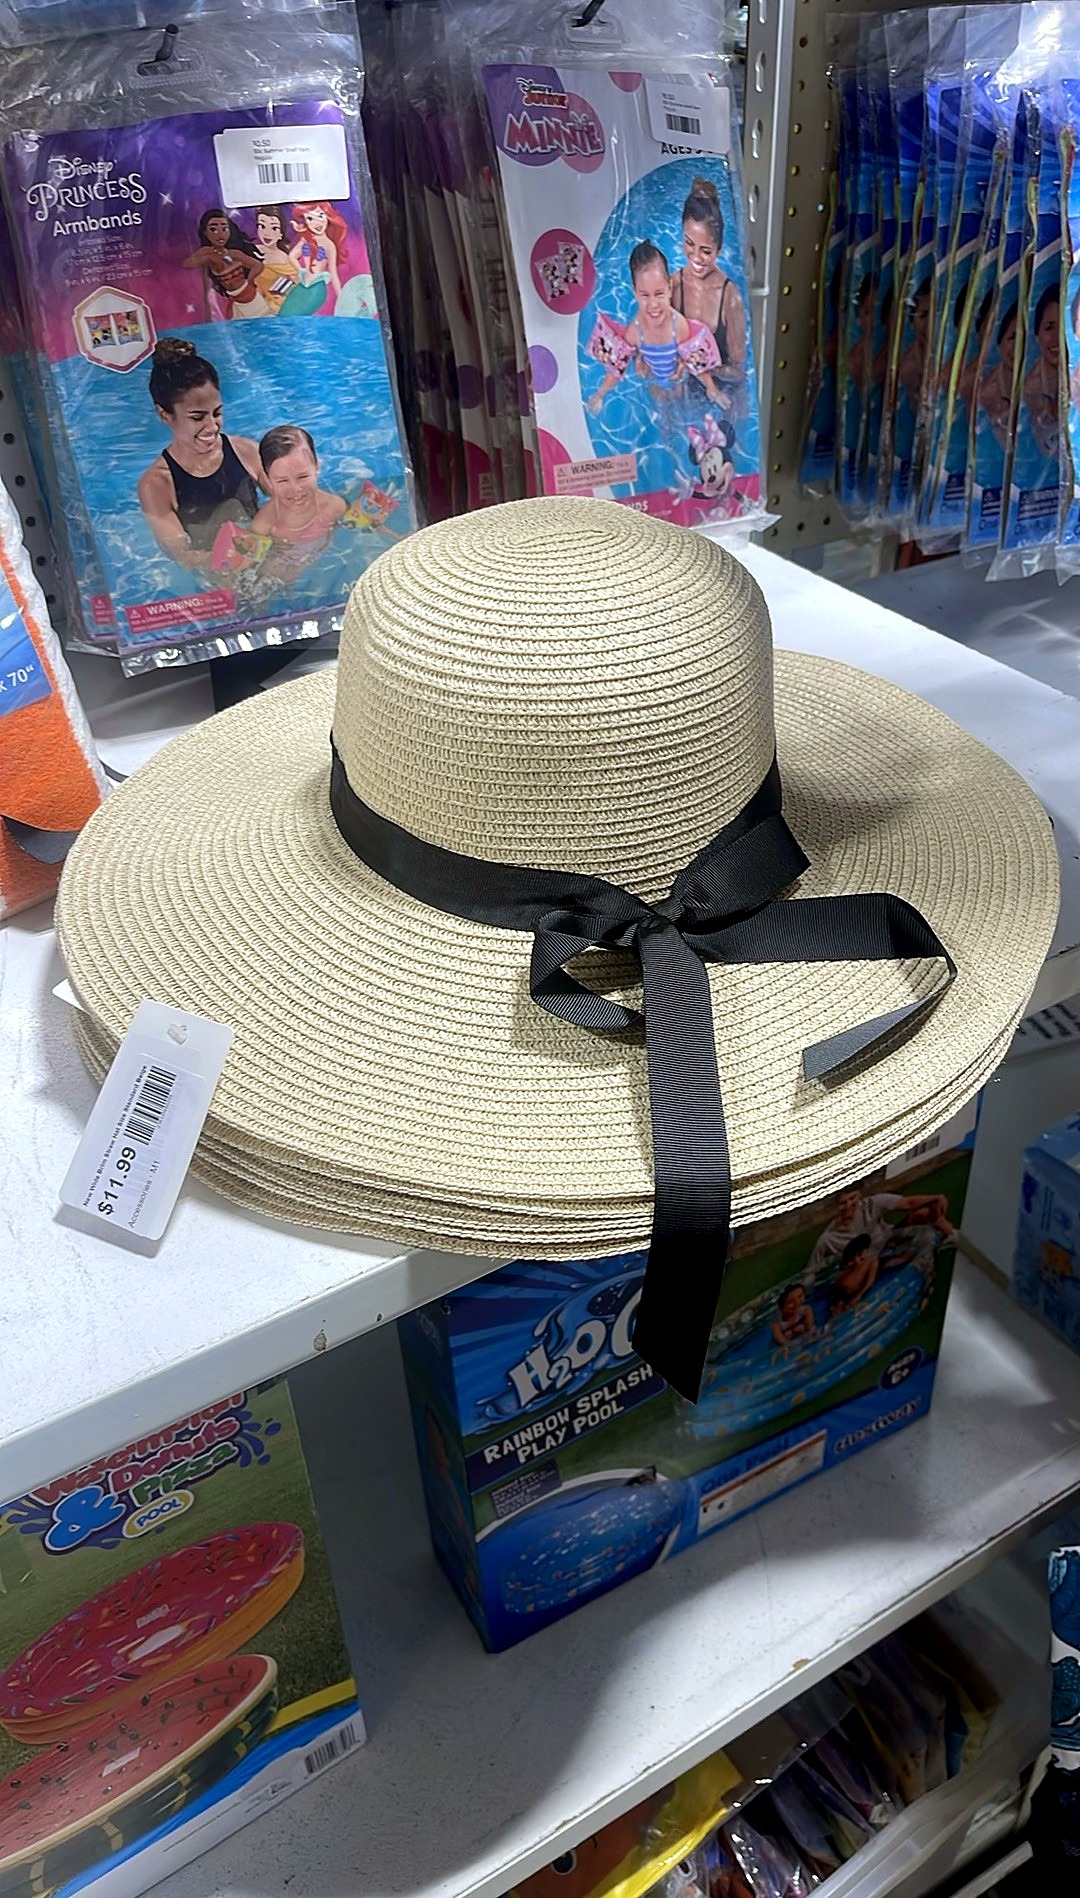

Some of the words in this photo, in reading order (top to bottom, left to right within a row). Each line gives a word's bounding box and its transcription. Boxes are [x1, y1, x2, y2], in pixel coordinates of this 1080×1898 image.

[26, 173, 147, 221] PRINCESS
[53, 210, 142, 237] Armbands
[569, 460, 613, 475] WARNING:
[146, 597, 205, 616] WARNING:
[97, 1146, 136, 1216] $11.99
[127, 1180, 153, 1228] Accessories
[483, 1409, 571, 1465] RAINBOW
[576, 1364, 654, 1416] SPLASH
[516, 1426, 568, 1465] PLAY
[573, 1400, 626, 1434] POOL
[108, 1416, 241, 1495] Donuts
[44, 1484, 127, 1551] &
[129, 1441, 240, 1508] Pizza
[136, 1498, 183, 1528] POOL
